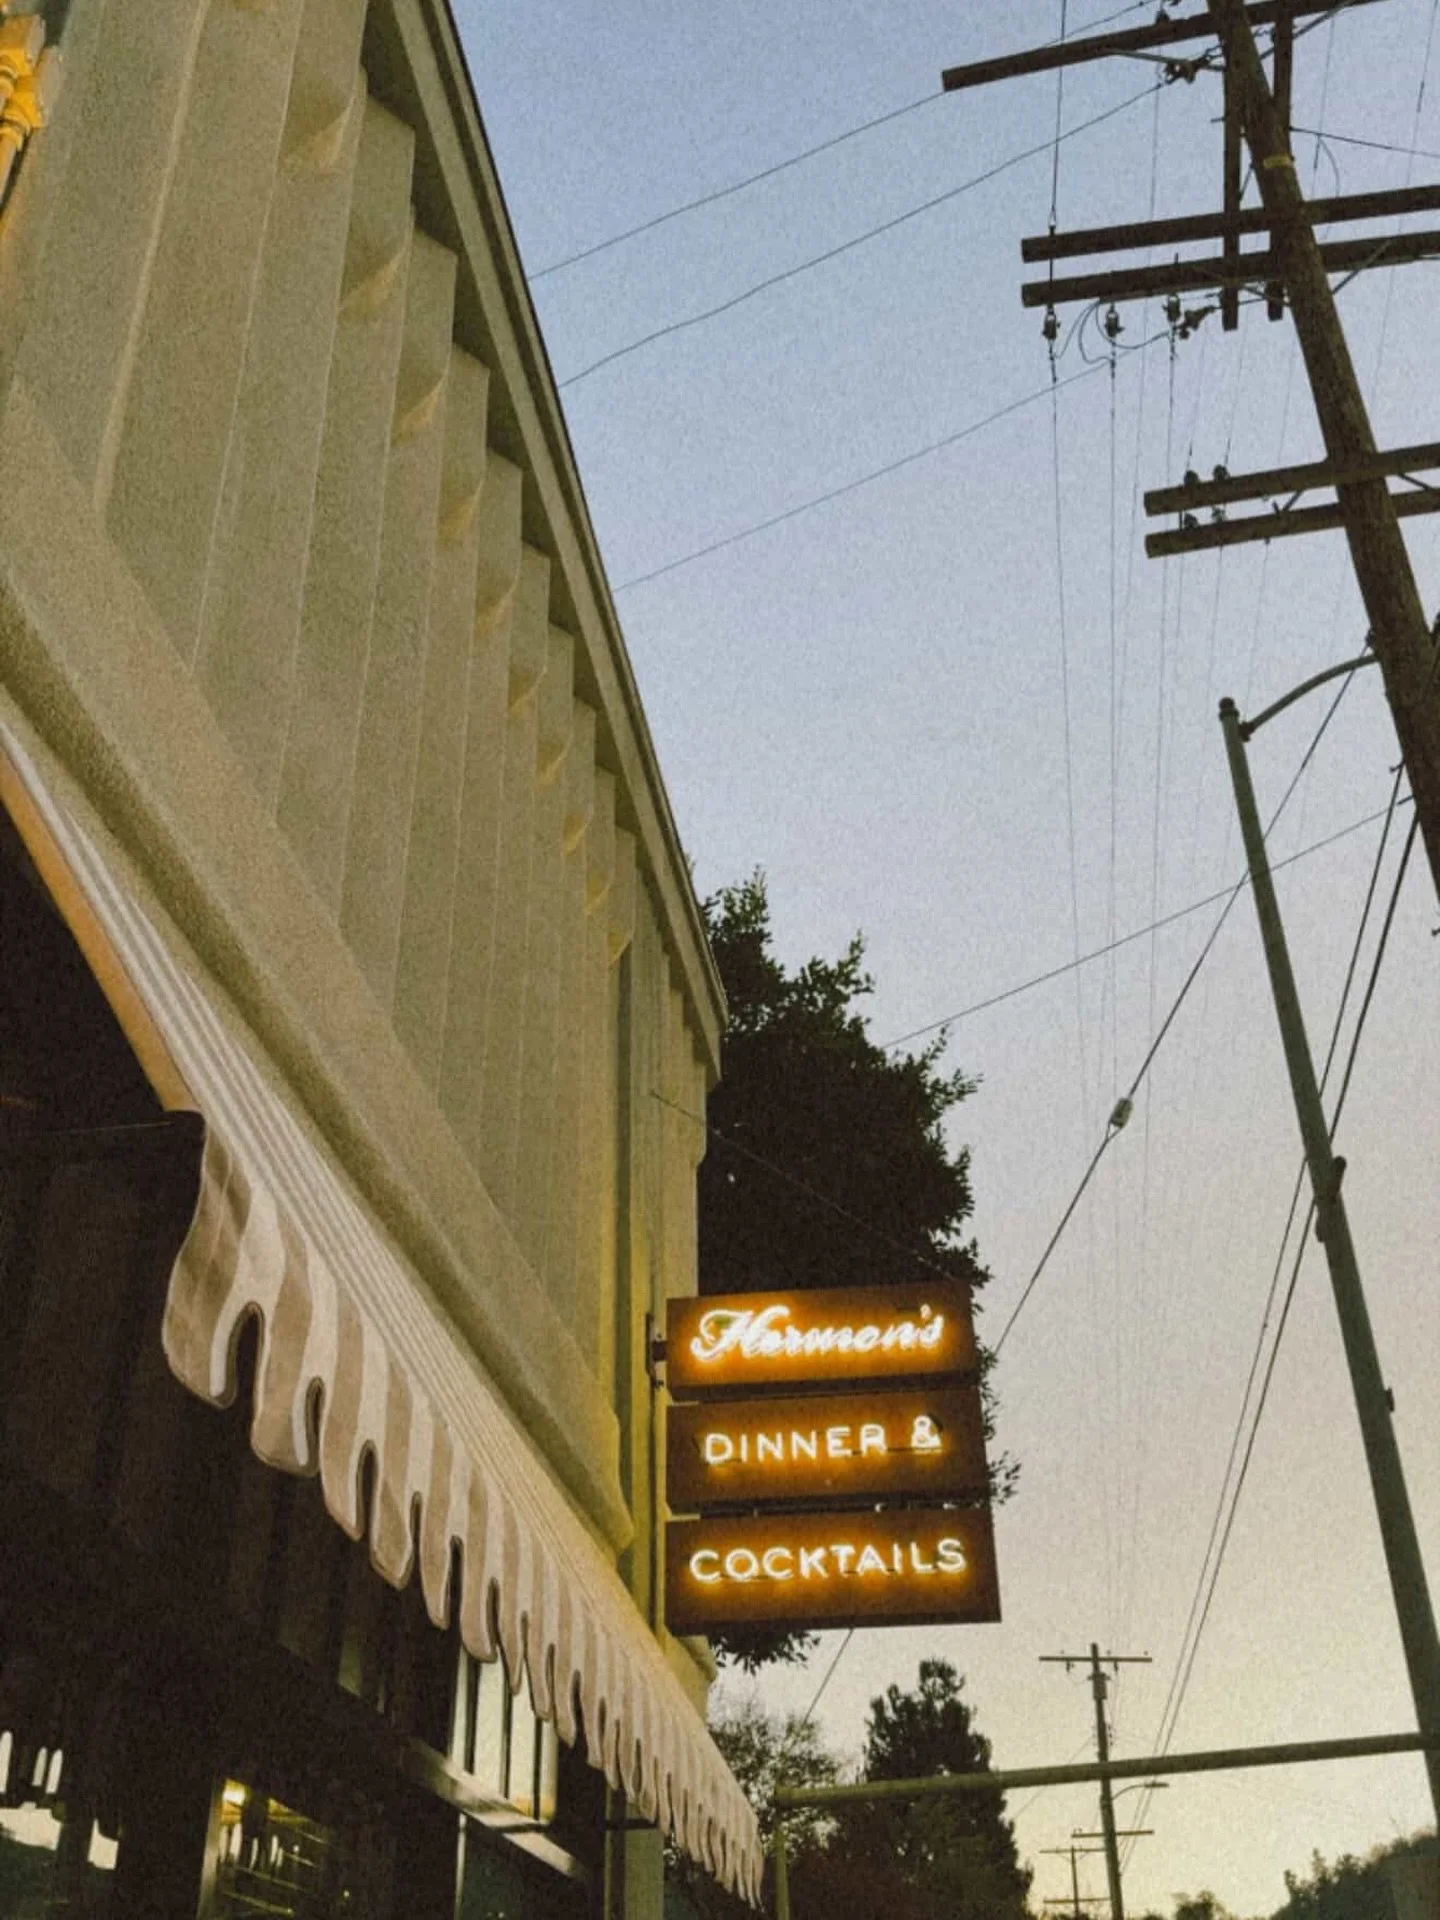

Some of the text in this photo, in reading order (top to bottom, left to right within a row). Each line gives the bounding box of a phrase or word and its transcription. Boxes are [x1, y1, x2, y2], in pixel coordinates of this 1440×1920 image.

[704, 1414, 942, 1465] DINNER &
[689, 1538, 968, 1583] COCKTAILS
